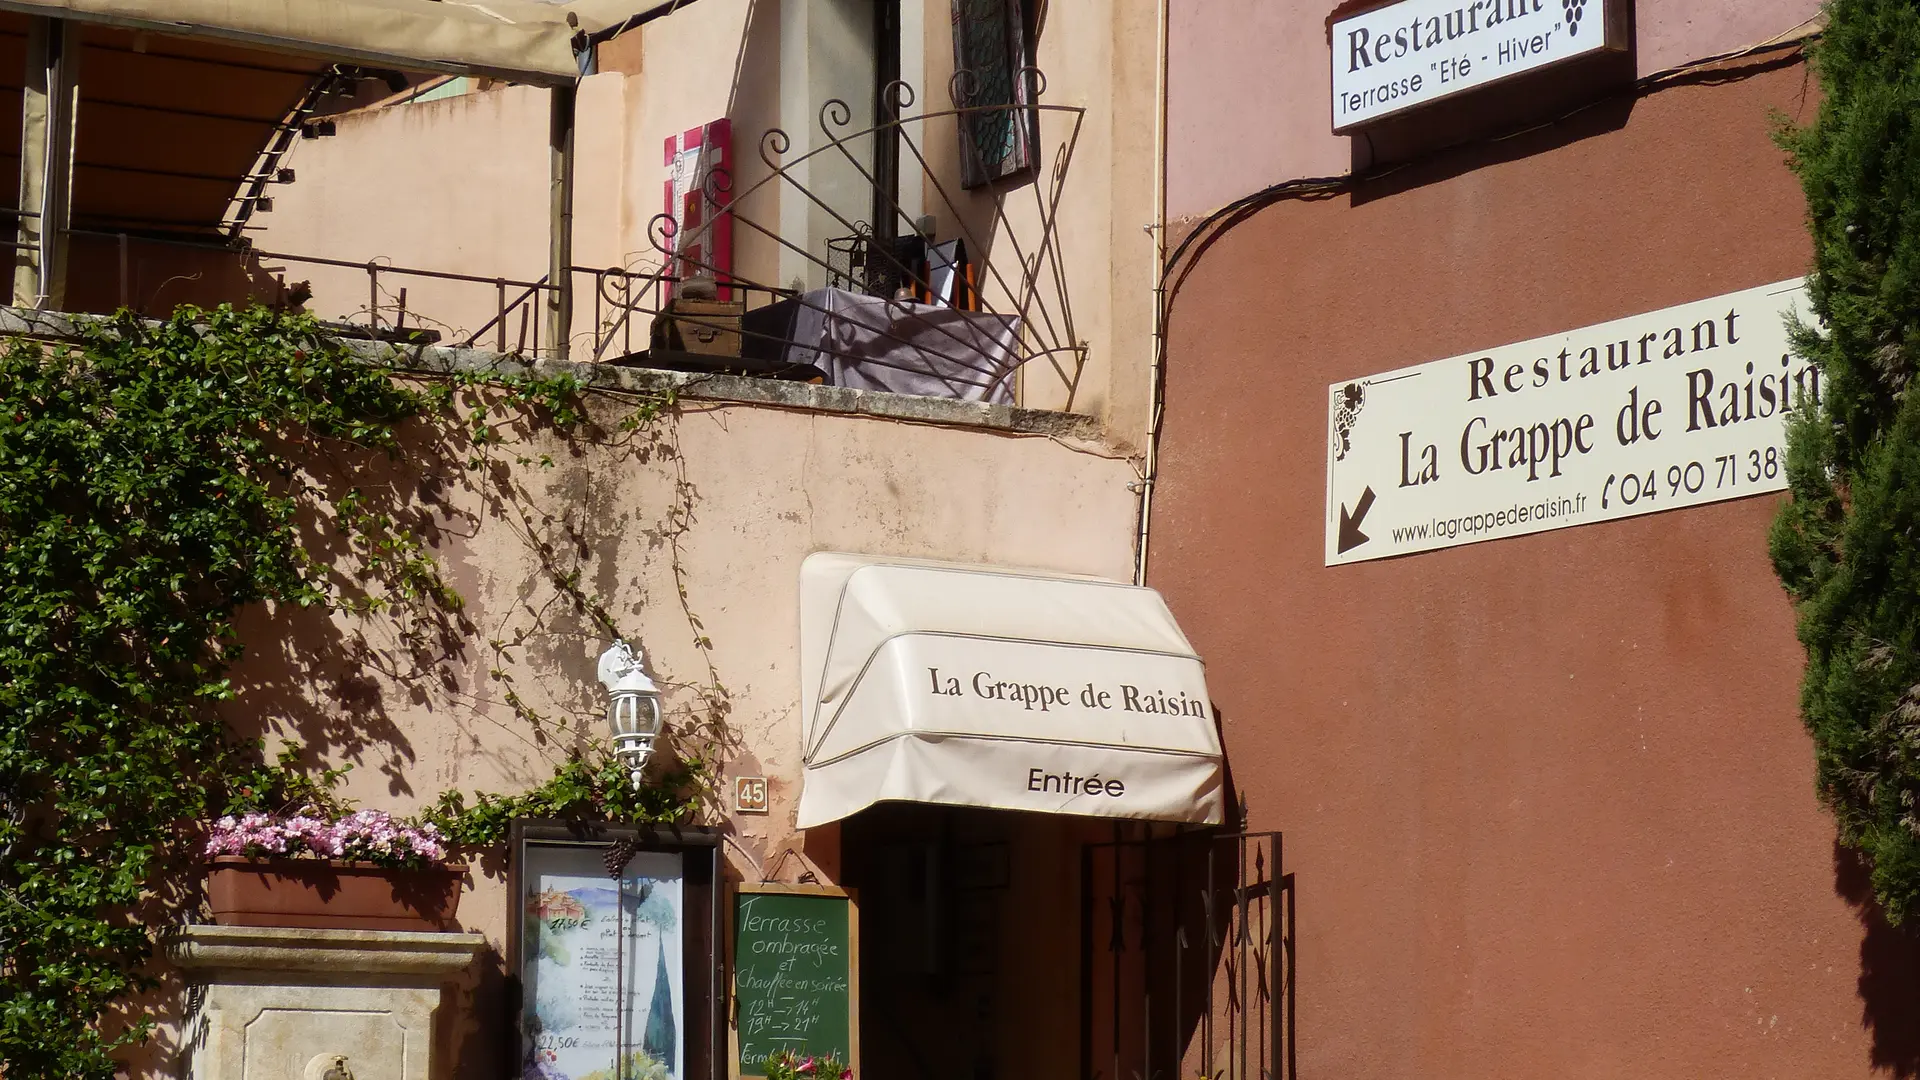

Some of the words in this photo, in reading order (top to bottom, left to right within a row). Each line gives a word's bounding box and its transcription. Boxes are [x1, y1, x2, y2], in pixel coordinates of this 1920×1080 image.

[1340, 74, 1423, 114] Terrasse
[1467, 308, 1741, 402] Restaurant
[1398, 431, 1440, 488] La
[1460, 413, 1594, 483] Grappe
[1616, 385, 1662, 447] de
[1685, 353, 1823, 433] Raisin
[1620, 469, 1657, 506] 04
[1667, 461, 1705, 497] 90
[1715, 454, 1736, 489] 71
[1747, 446, 1778, 483] 38
[1392, 492, 1587, 544] www.lagrappederaisin.fr
[927, 667, 963, 697] La
[972, 671, 1070, 712] Grappe
[1081, 682, 1112, 710] de
[1123, 684, 1207, 719] Raisin
[740, 783, 764, 803] 45
[1027, 767, 1125, 798] Entrée
[740, 896, 826, 933] Terrasse
[752, 933, 838, 968] ombragée
[779, 955, 797, 972] et
[794, 979, 808, 990] en
[811, 976, 847, 992] soirée
